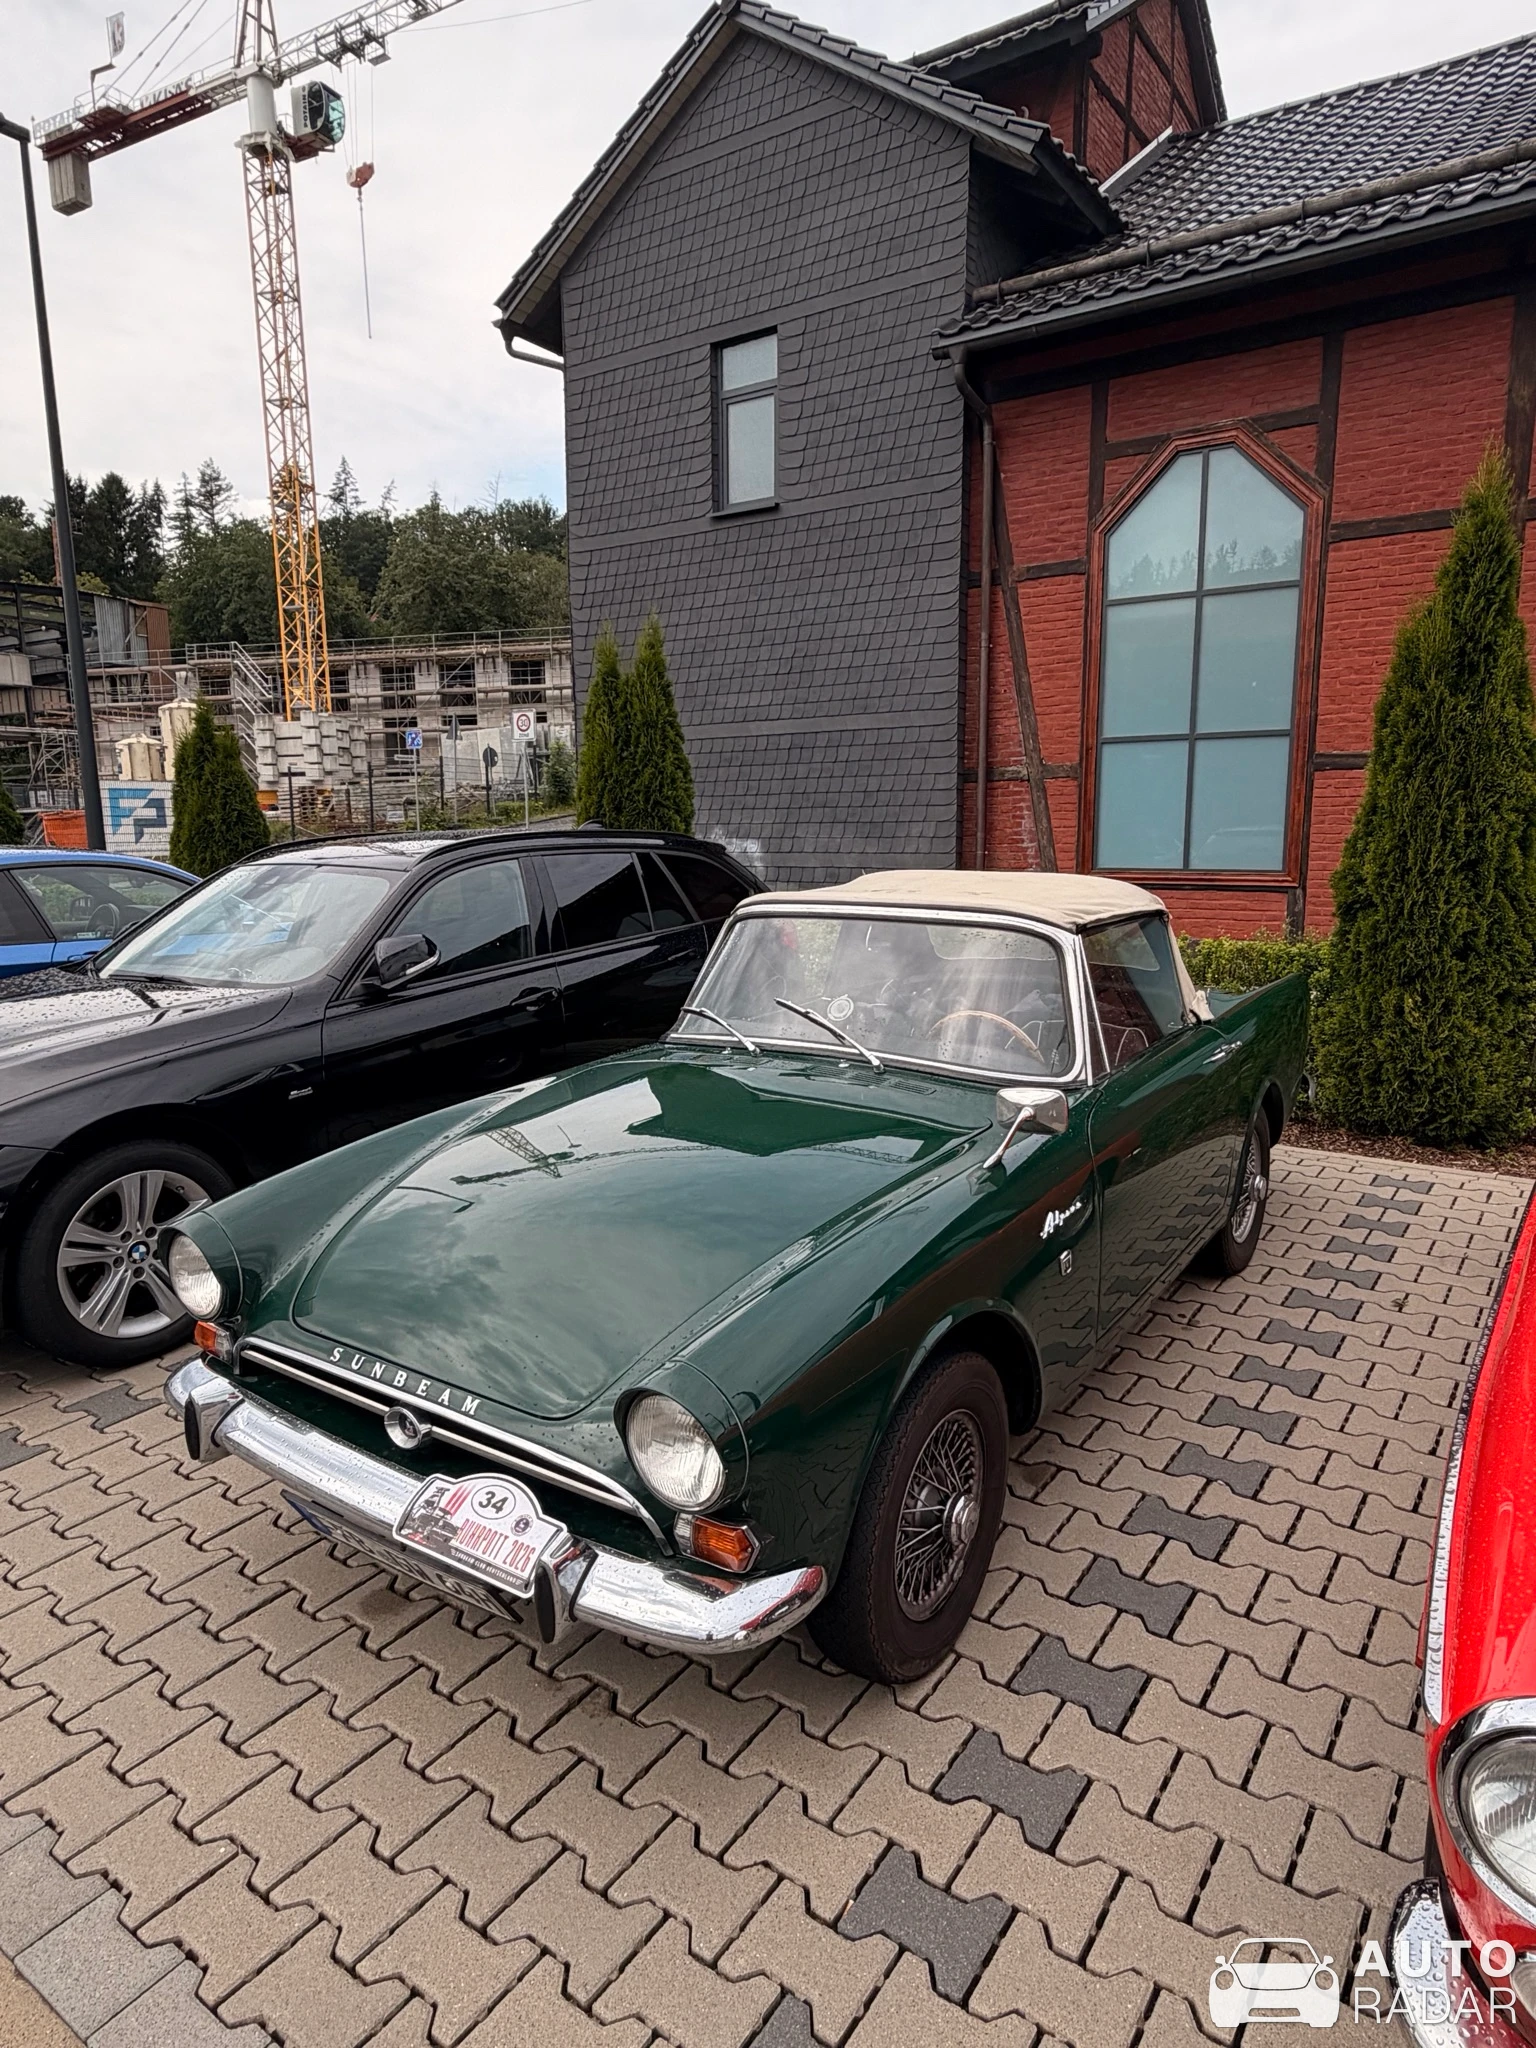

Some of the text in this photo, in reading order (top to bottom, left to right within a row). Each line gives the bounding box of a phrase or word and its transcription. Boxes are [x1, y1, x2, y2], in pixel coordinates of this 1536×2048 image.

[329, 1347, 482, 1416] SUNBEAM
[478, 1490, 509, 1515] 34
[455, 1518, 509, 1560] RUHRPOTT
[502, 1539, 537, 1573] 2026
